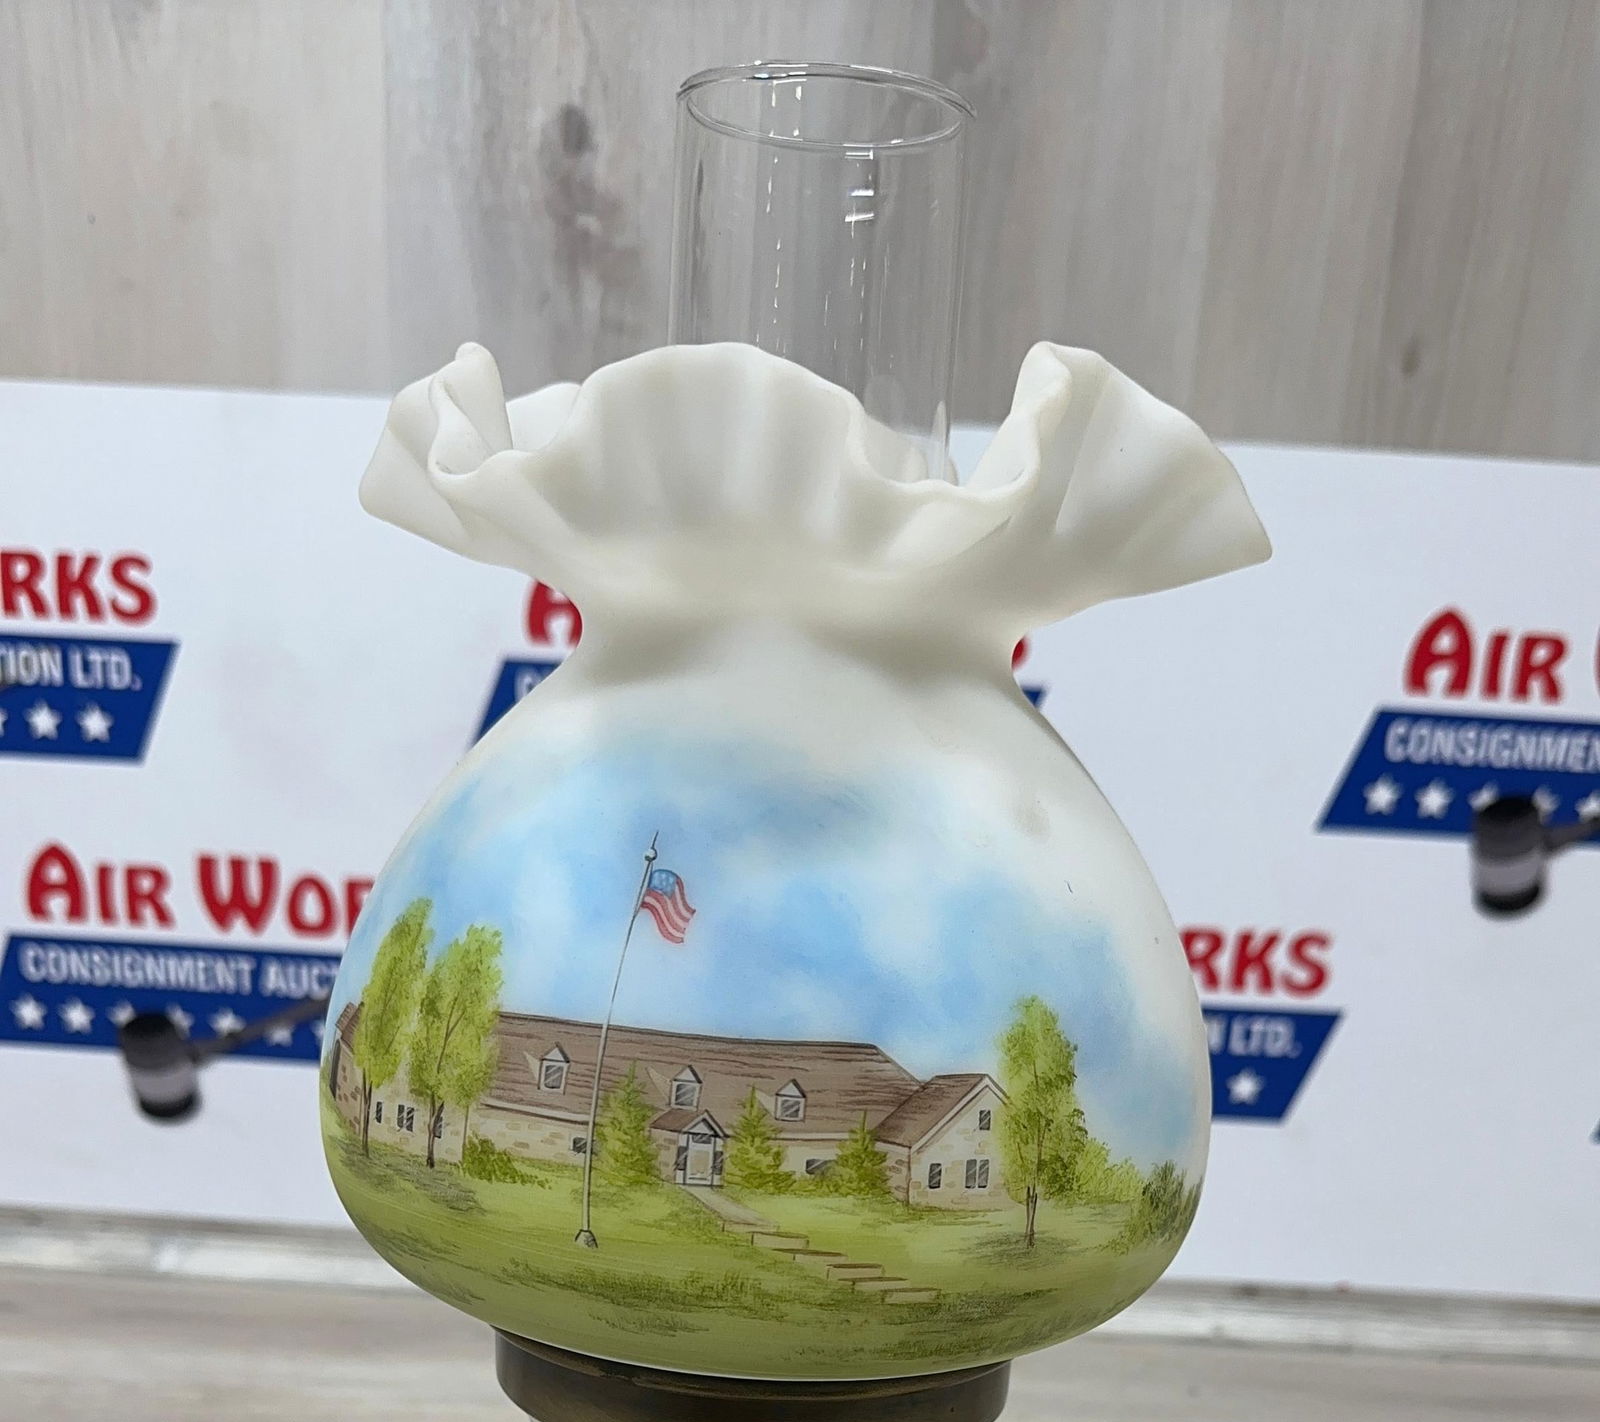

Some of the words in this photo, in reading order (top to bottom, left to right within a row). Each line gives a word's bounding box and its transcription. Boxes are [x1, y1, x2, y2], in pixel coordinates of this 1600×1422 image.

[68, 644, 143, 691] LTD.
[1404, 606, 1569, 704] AIR
[25, 842, 173, 928] AIR
[20, 943, 254, 995] CONSIGNMENT
[1179, 928, 1332, 997] RKS
[1229, 1015, 1302, 1059] LTD.
